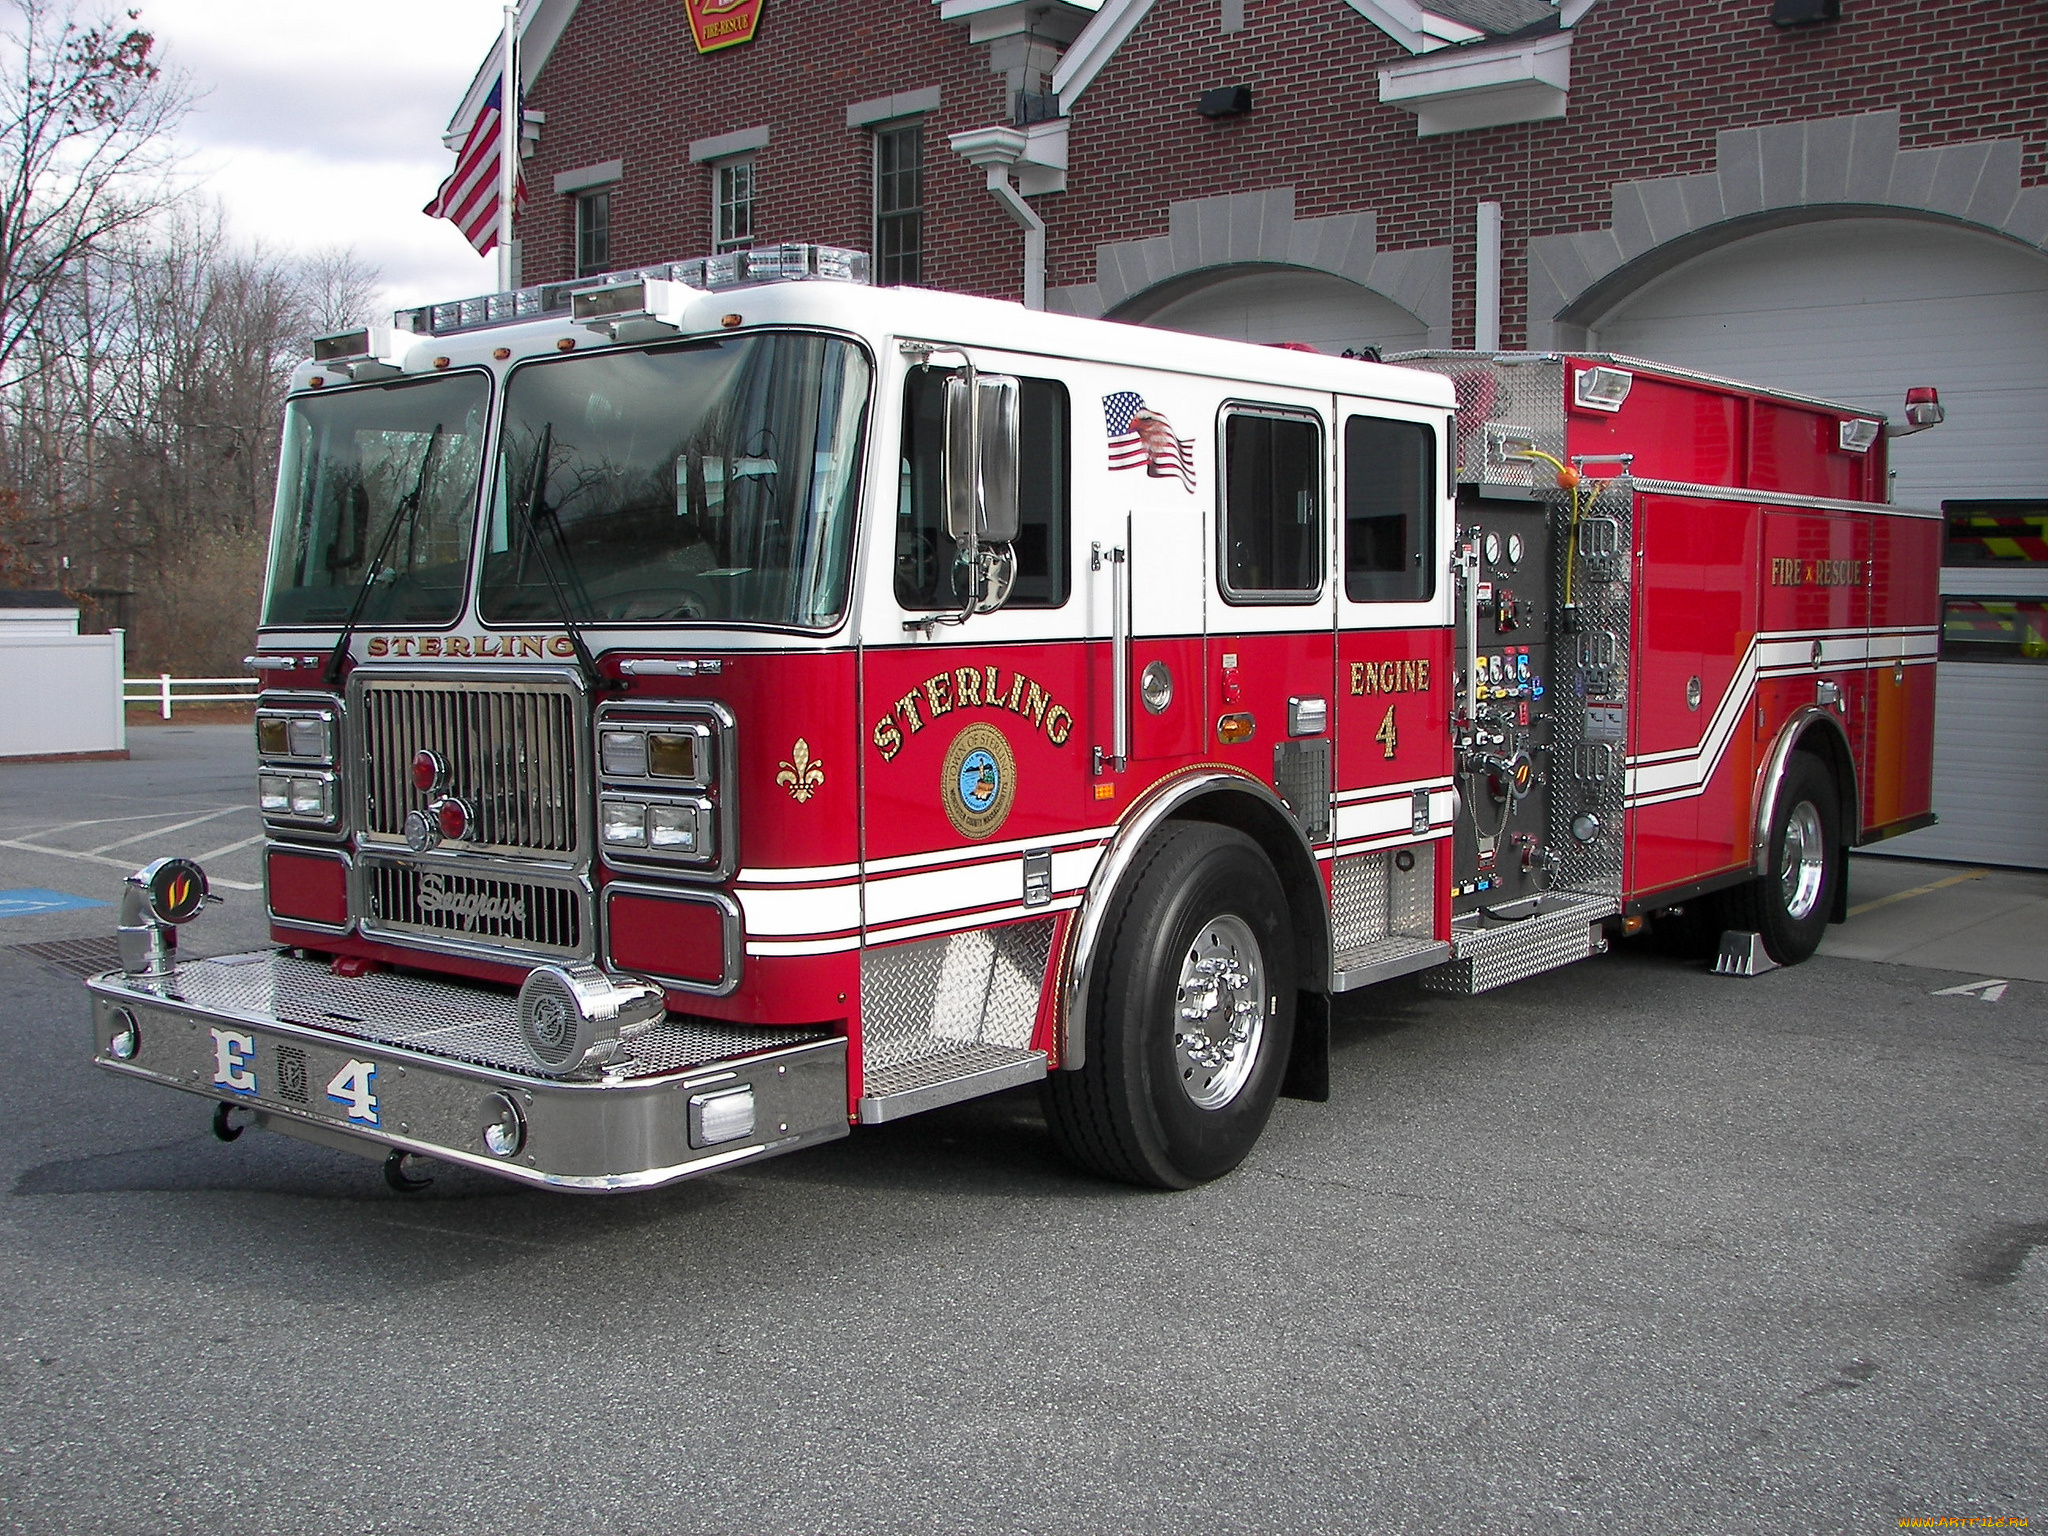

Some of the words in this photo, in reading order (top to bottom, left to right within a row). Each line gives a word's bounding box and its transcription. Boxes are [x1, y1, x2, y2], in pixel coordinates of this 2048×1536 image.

[1771, 557, 1801, 586] FIRE
[1816, 559, 1861, 586] RESCUE
[367, 635, 577, 659] STERLING
[1349, 659, 1430, 696] ENGINE
[872, 665, 1074, 763] STERLING
[1375, 703, 1398, 760] 4
[967, 733, 978, 748] OF
[417, 873, 527, 932] Seagrave
[211, 1026, 258, 1094] E
[326, 1057, 381, 1129] 4
